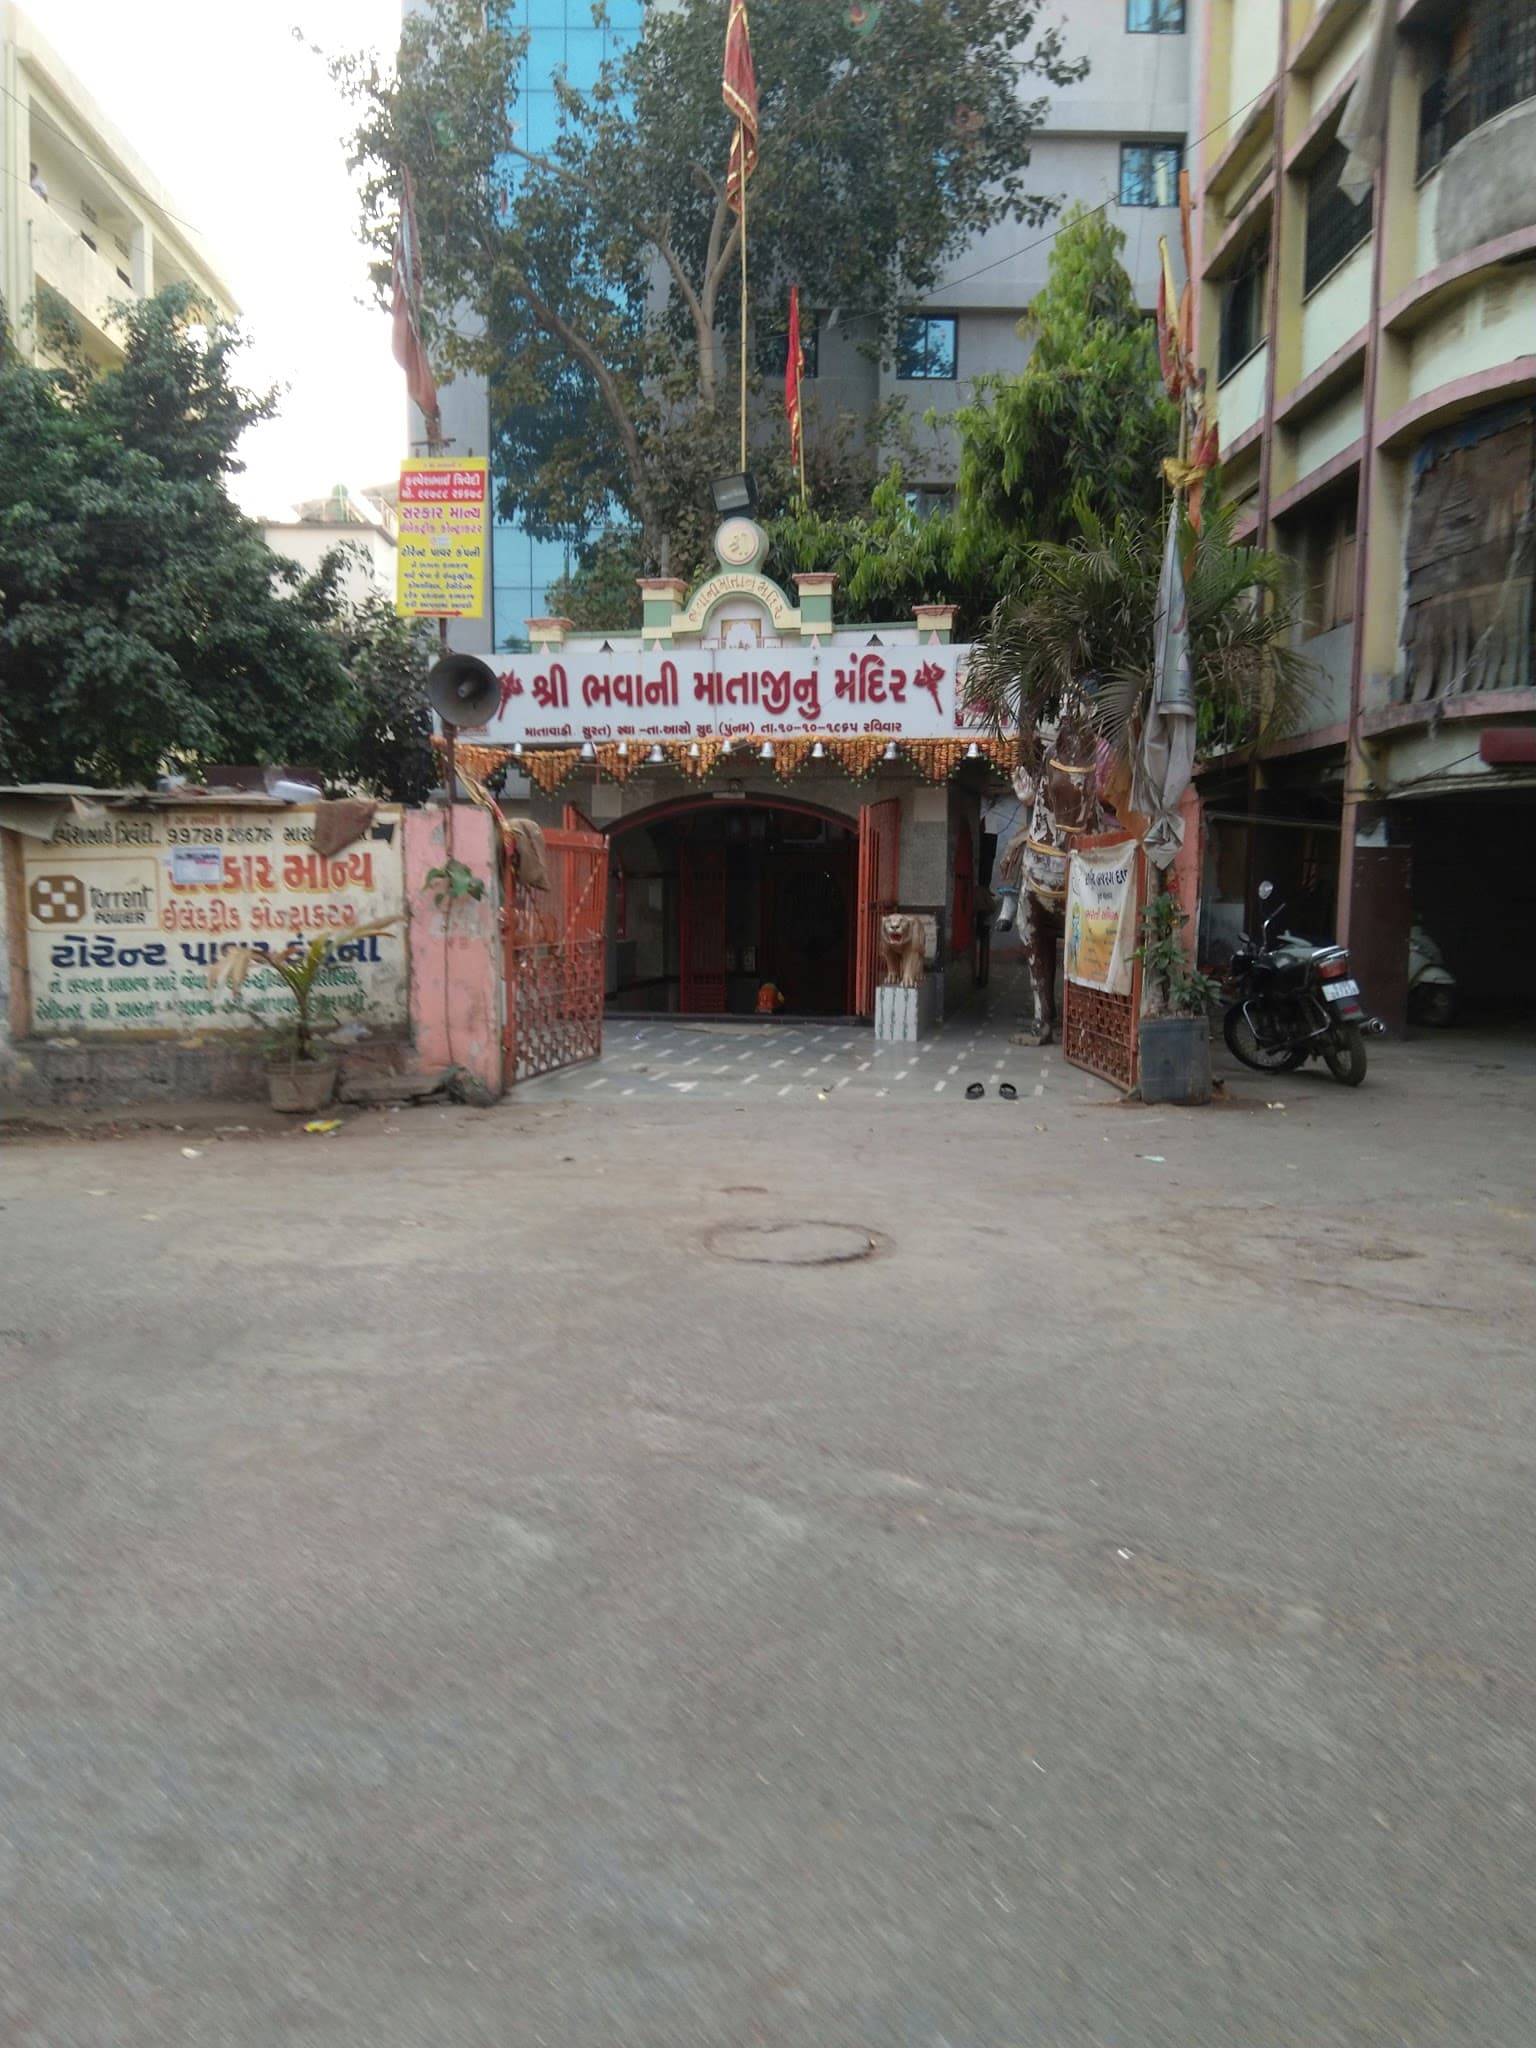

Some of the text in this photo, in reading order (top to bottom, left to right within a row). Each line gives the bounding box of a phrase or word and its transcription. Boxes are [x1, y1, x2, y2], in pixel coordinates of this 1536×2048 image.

[402, 507, 481, 520] સરકાર માન્ય
[531, 663, 570, 709] શ્રી
[582, 660, 680, 707] ભવાની
[834, 652, 907, 704] મંદિર
[863, 718, 903, 734] રવિવાર
[166, 826, 225, 844] 99788
[284, 853, 374, 891] માન્ય
[94, 911, 146, 925] POWER
[51, 934, 167, 968] ટોરેન્ટ
